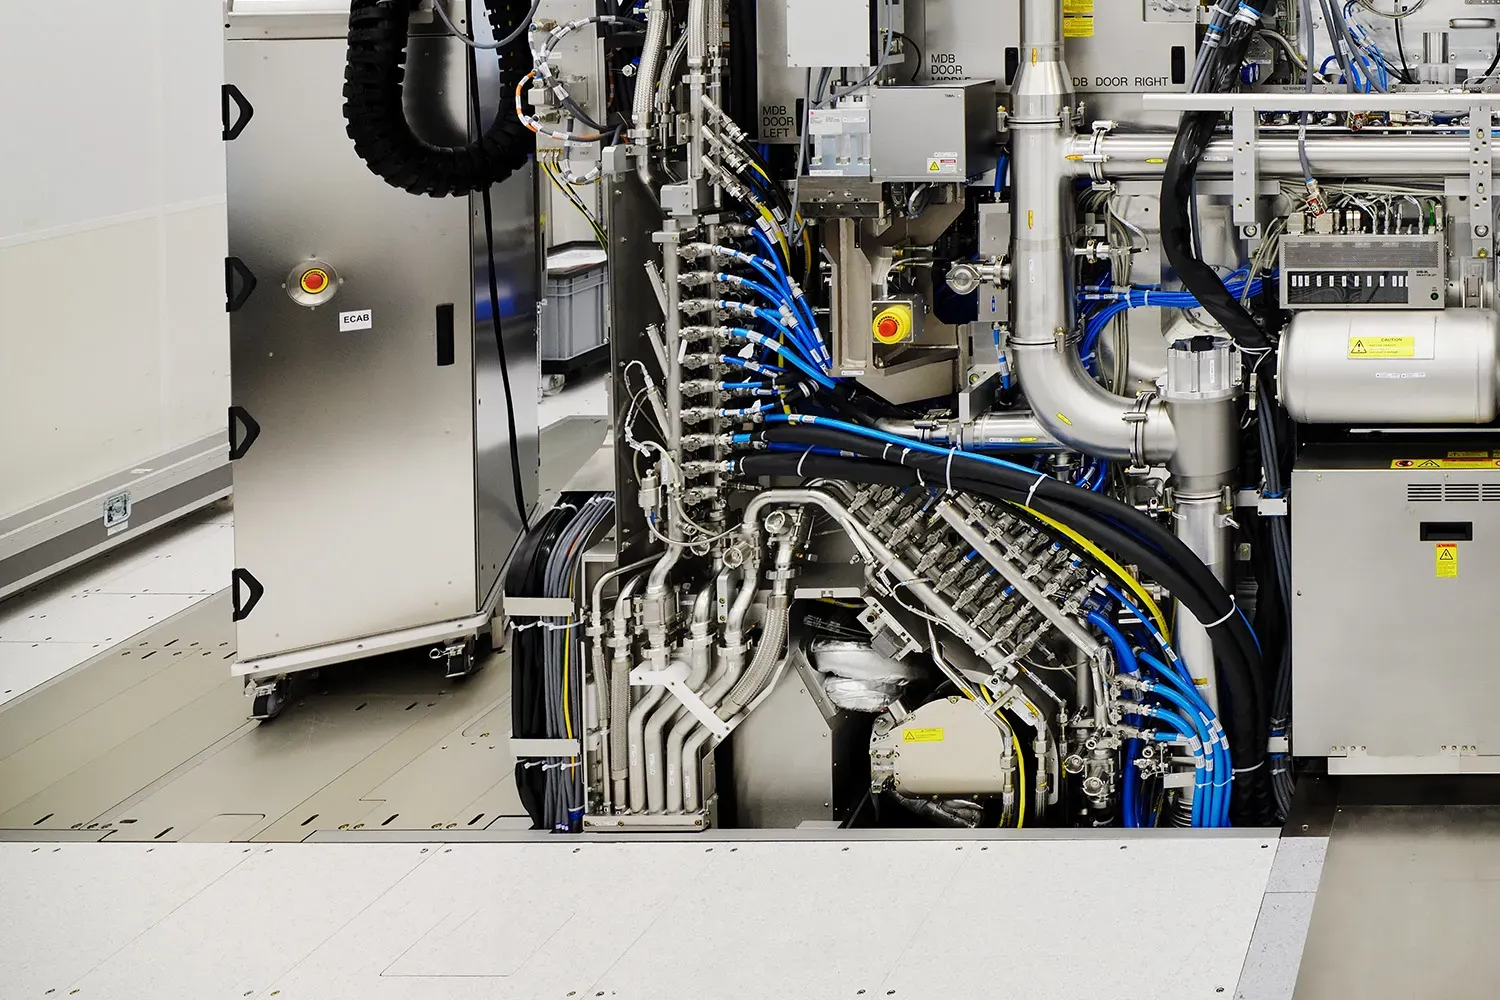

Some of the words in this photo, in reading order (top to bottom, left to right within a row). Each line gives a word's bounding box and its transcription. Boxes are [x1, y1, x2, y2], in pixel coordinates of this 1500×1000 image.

[931, 53, 956, 64] MDB
[931, 65, 963, 75] DOOR
[1070, 76, 1089, 87] DB
[1095, 76, 1128, 87] DOOR
[1134, 76, 1168, 87] RIGHT
[762, 105, 787, 116] MDB
[762, 116, 795, 127] DOOR
[763, 128, 790, 139] LEFT
[343, 313, 370, 324] ECAB
